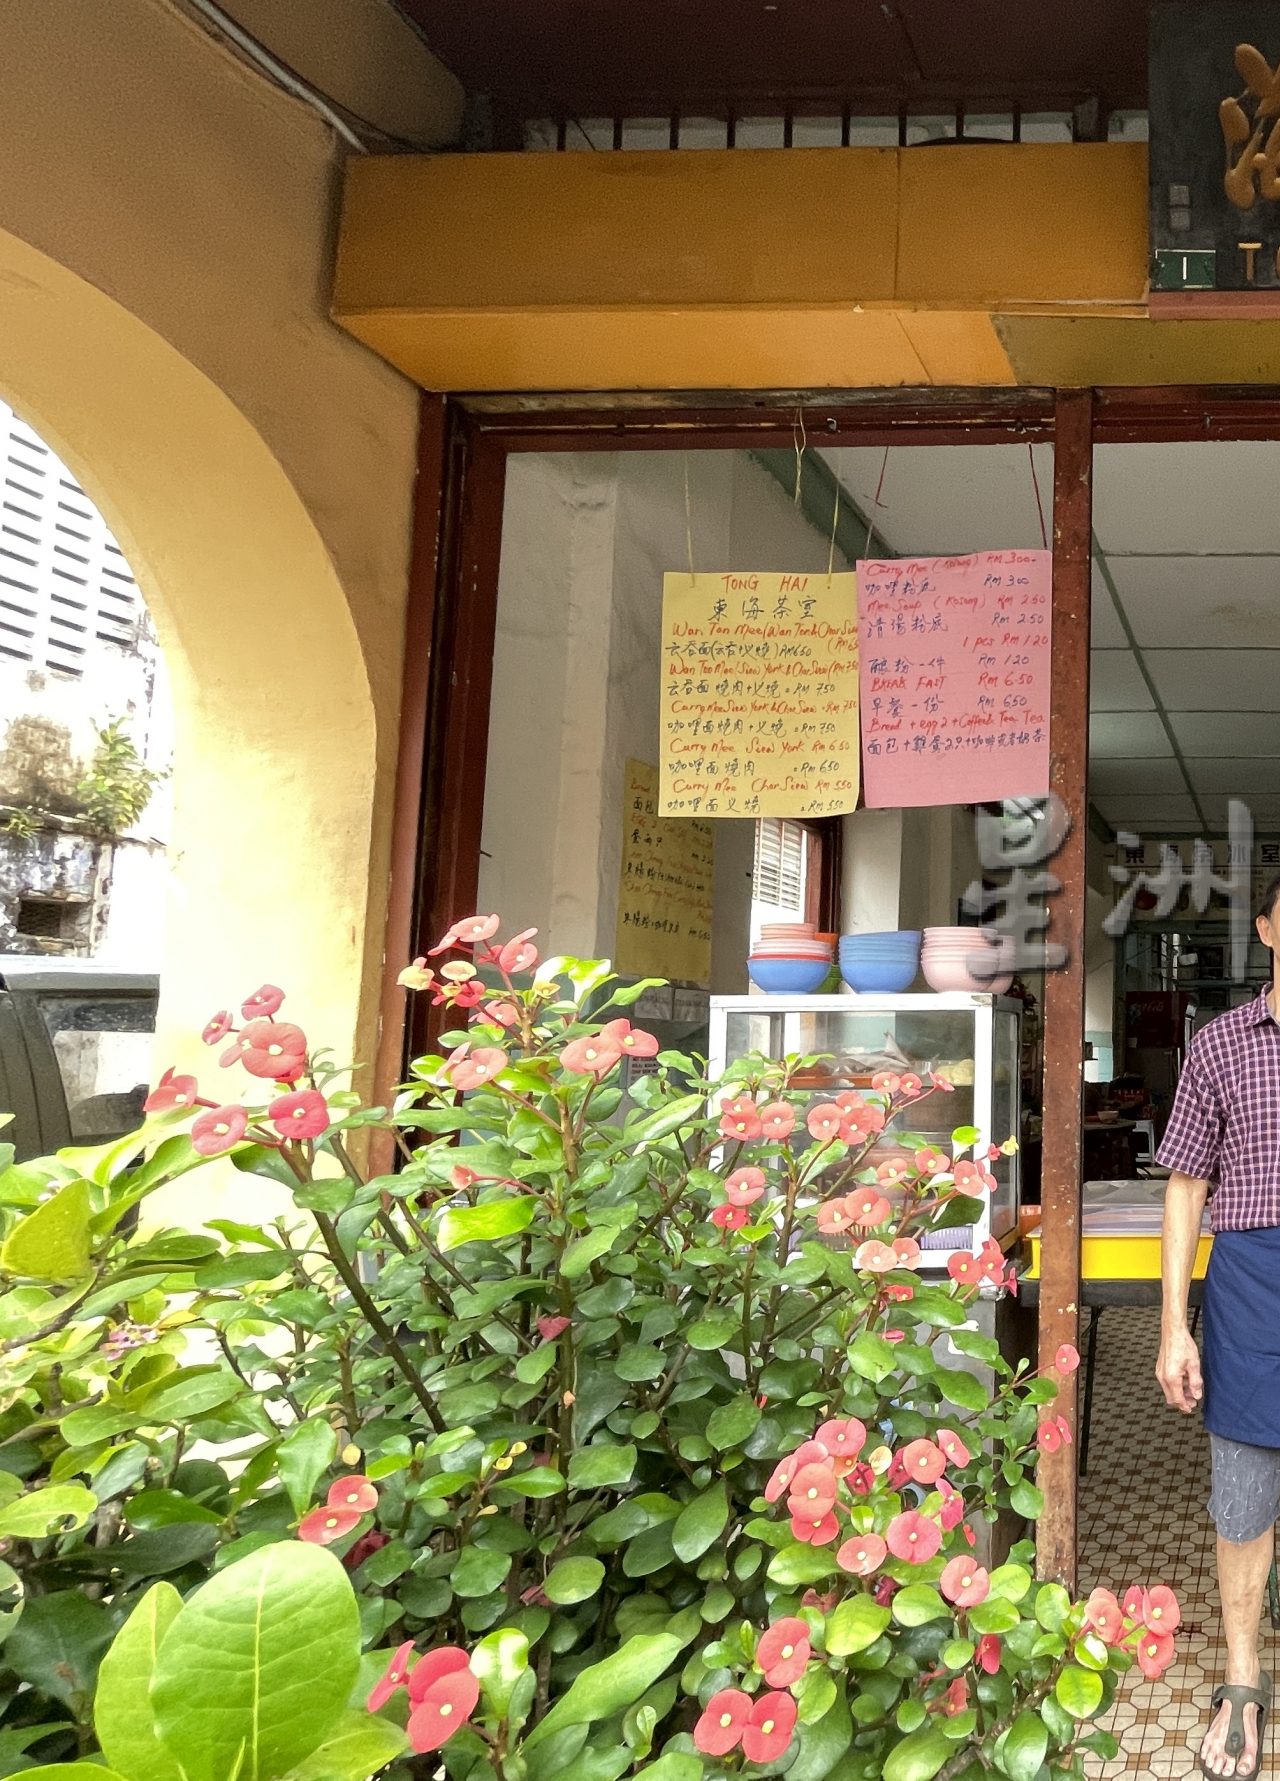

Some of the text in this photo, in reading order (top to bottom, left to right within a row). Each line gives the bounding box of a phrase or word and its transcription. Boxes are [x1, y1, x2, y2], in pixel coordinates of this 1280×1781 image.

[721, 574, 808, 593] TONG HAI
[708, 594, 817, 621] 東海茶室
[670, 737, 706, 758] Curry
[673, 778, 709, 800] Curry
